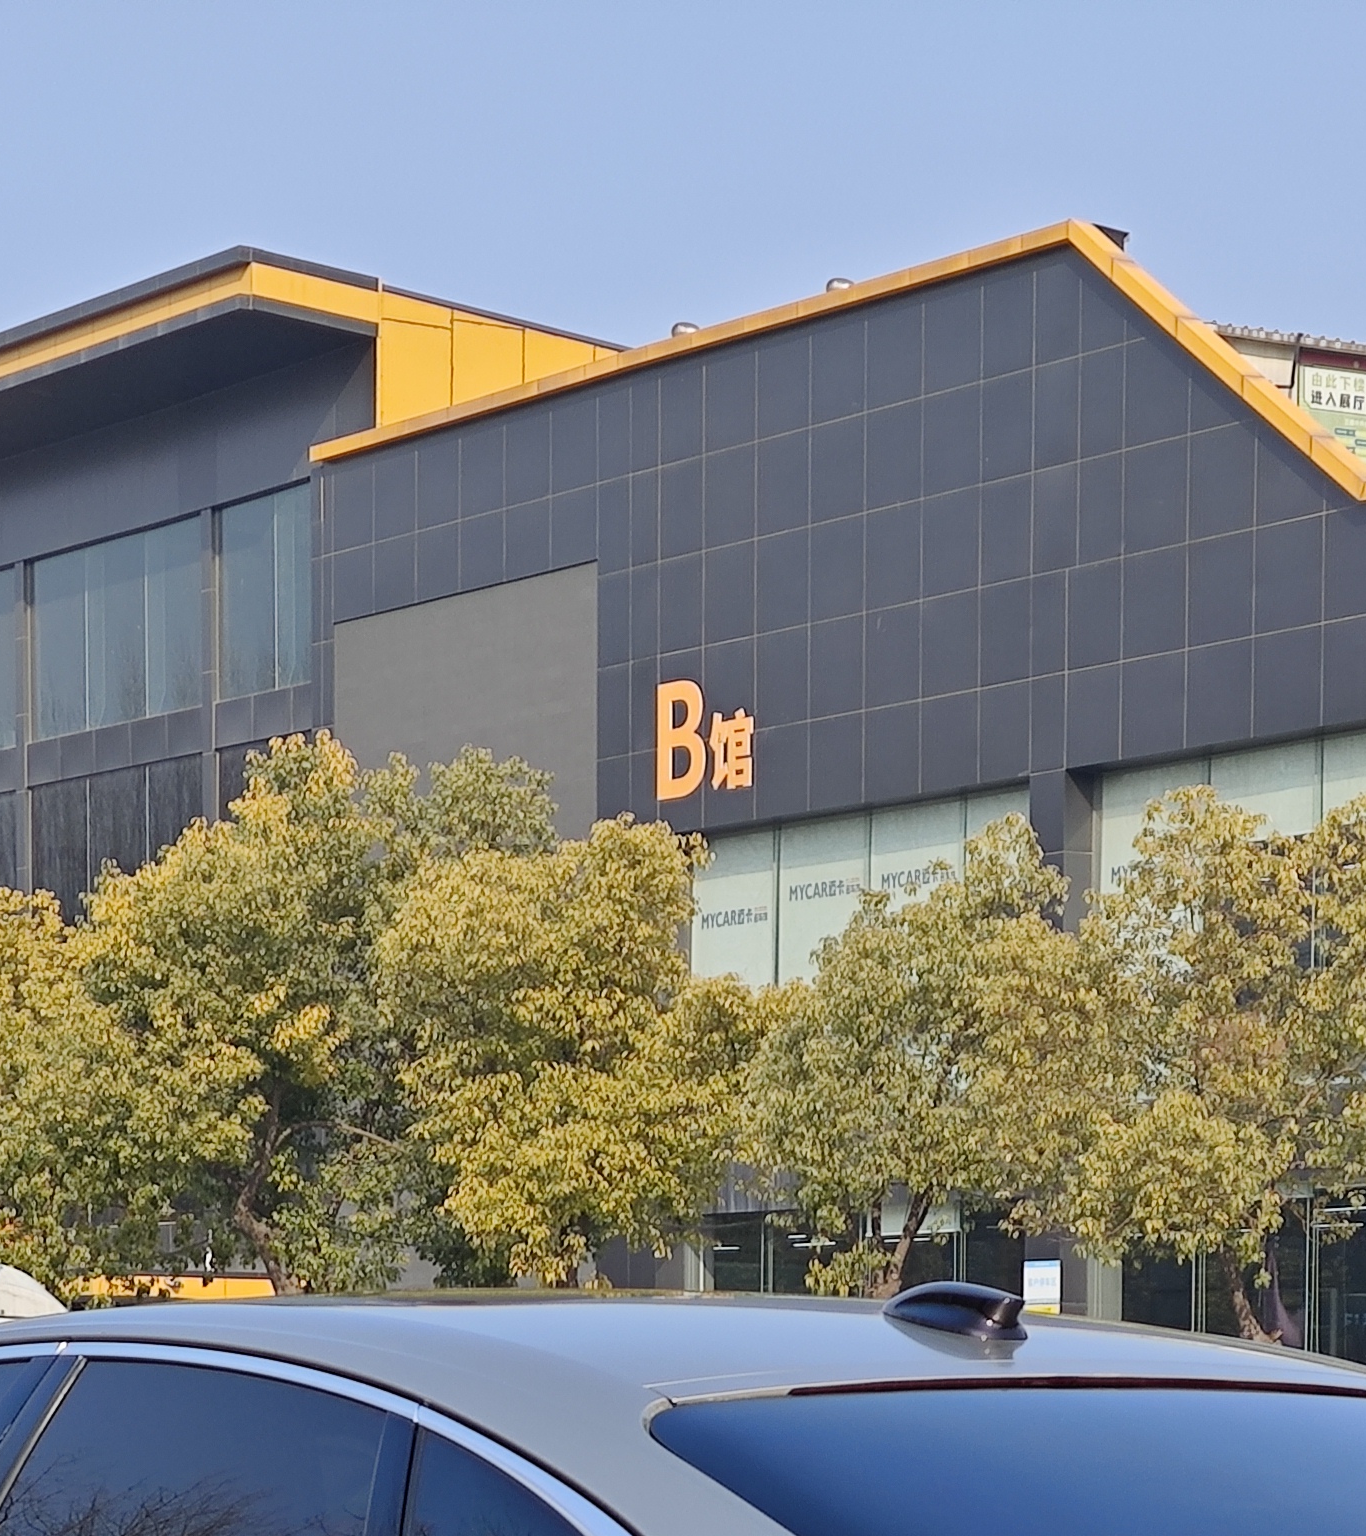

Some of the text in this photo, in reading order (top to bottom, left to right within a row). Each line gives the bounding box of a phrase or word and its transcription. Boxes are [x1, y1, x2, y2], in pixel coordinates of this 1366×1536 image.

[1311, 390, 1365, 411] 进入展厅
[657, 679, 754, 801] B馆
